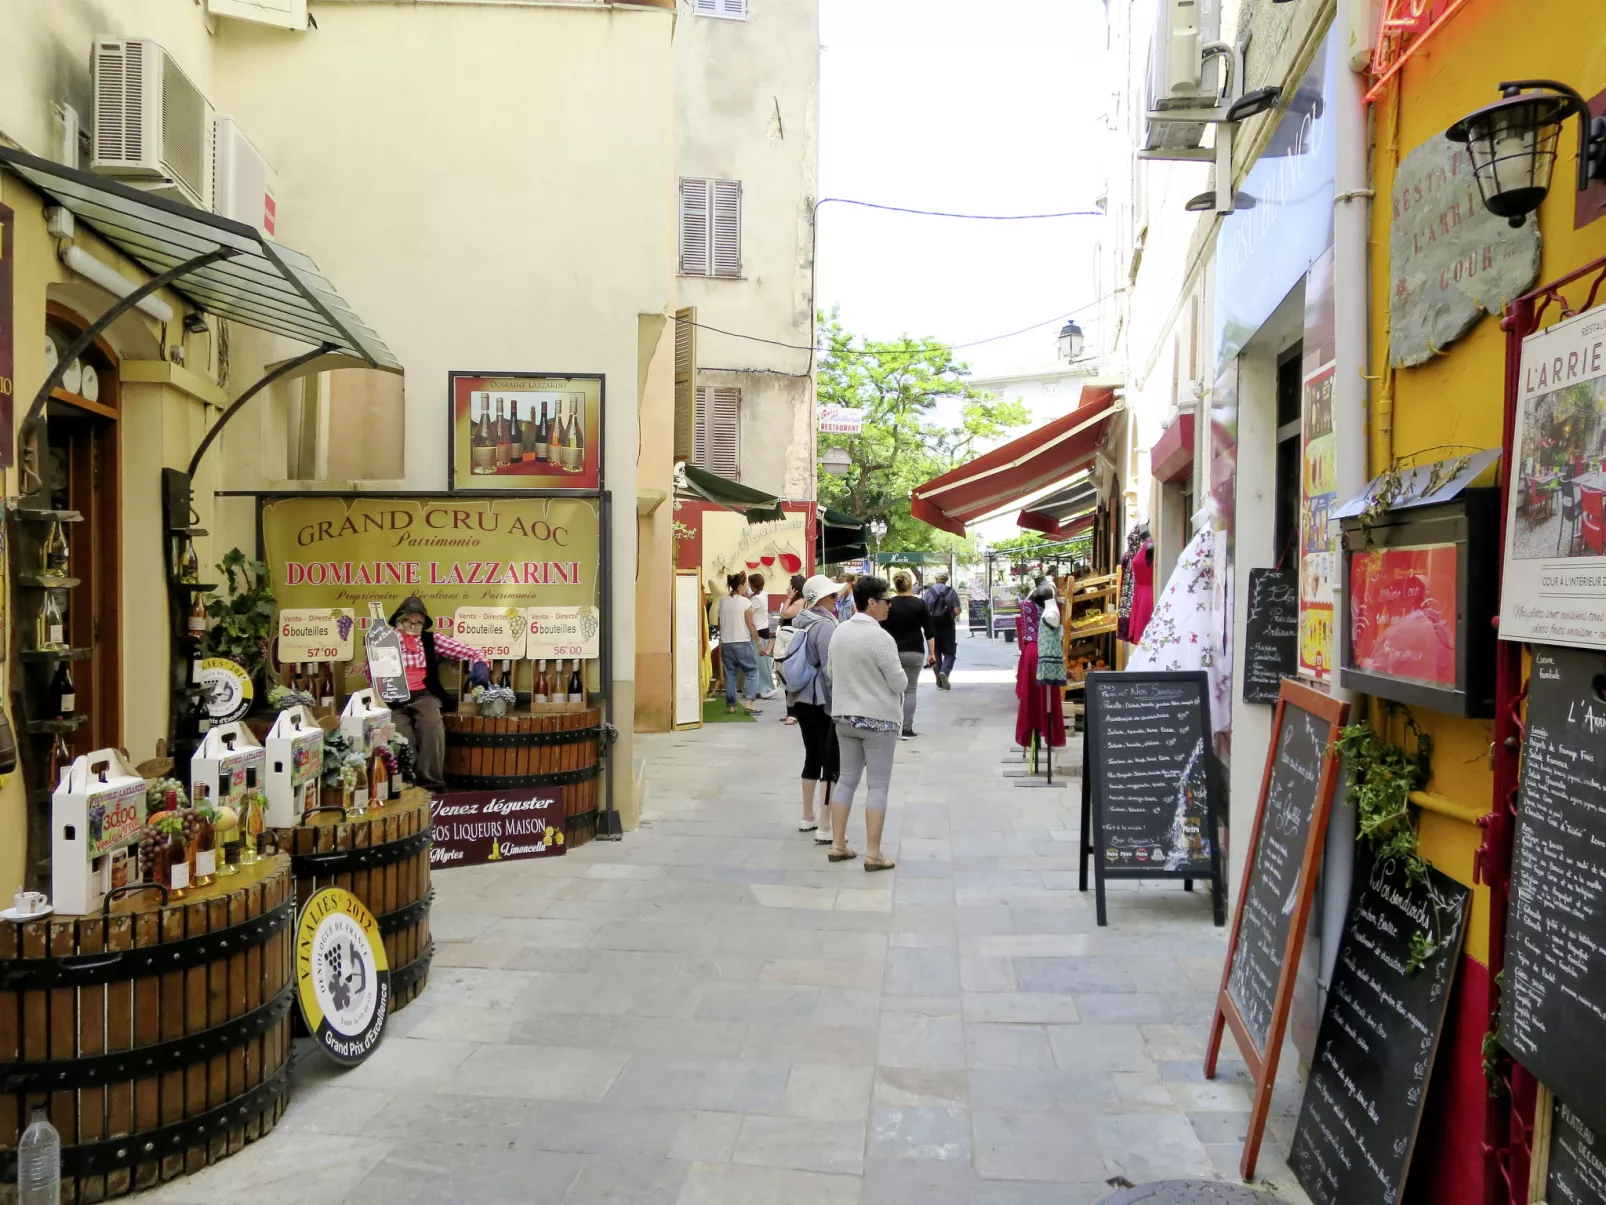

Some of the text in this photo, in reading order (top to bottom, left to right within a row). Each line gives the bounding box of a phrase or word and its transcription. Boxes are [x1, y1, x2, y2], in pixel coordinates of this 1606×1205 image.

[1391, 150, 1474, 222] RESTAU
[1413, 185, 1475, 256] L'ARRI
[1439, 246, 1493, 291] COUR
[1525, 342, 1602, 394] L'ARRIE
[490, 380, 567, 388] DOMAINE LAZZARINI
[820, 423, 859, 432] RESTAURANT
[297, 509, 569, 548] GRAND CRU AOC
[390, 531, 480, 548] Patrimonio
[285, 561, 582, 586] DOMAINE LAZZARINI
[1542, 576, 1558, 586] COUR
[336, 588, 398, 604] Propriétaire
[480, 590, 538, 600] Patrimonio
[282, 624, 328, 637] 6 bouteilles
[457, 622, 466, 634] 6
[466, 624, 503, 634] bouteilles
[530, 622, 576, 634] 6 bouteilles
[482, 797, 555, 816] déguster
[453, 821, 502, 842] LIQUEURS
[506, 818, 546, 836] MAISON
[300, 894, 372, 980] VINALIES 2012
[325, 982, 388, 1056] Grand Prix d'Excellence
[1562, 1104, 1596, 1146] PLATEAU
